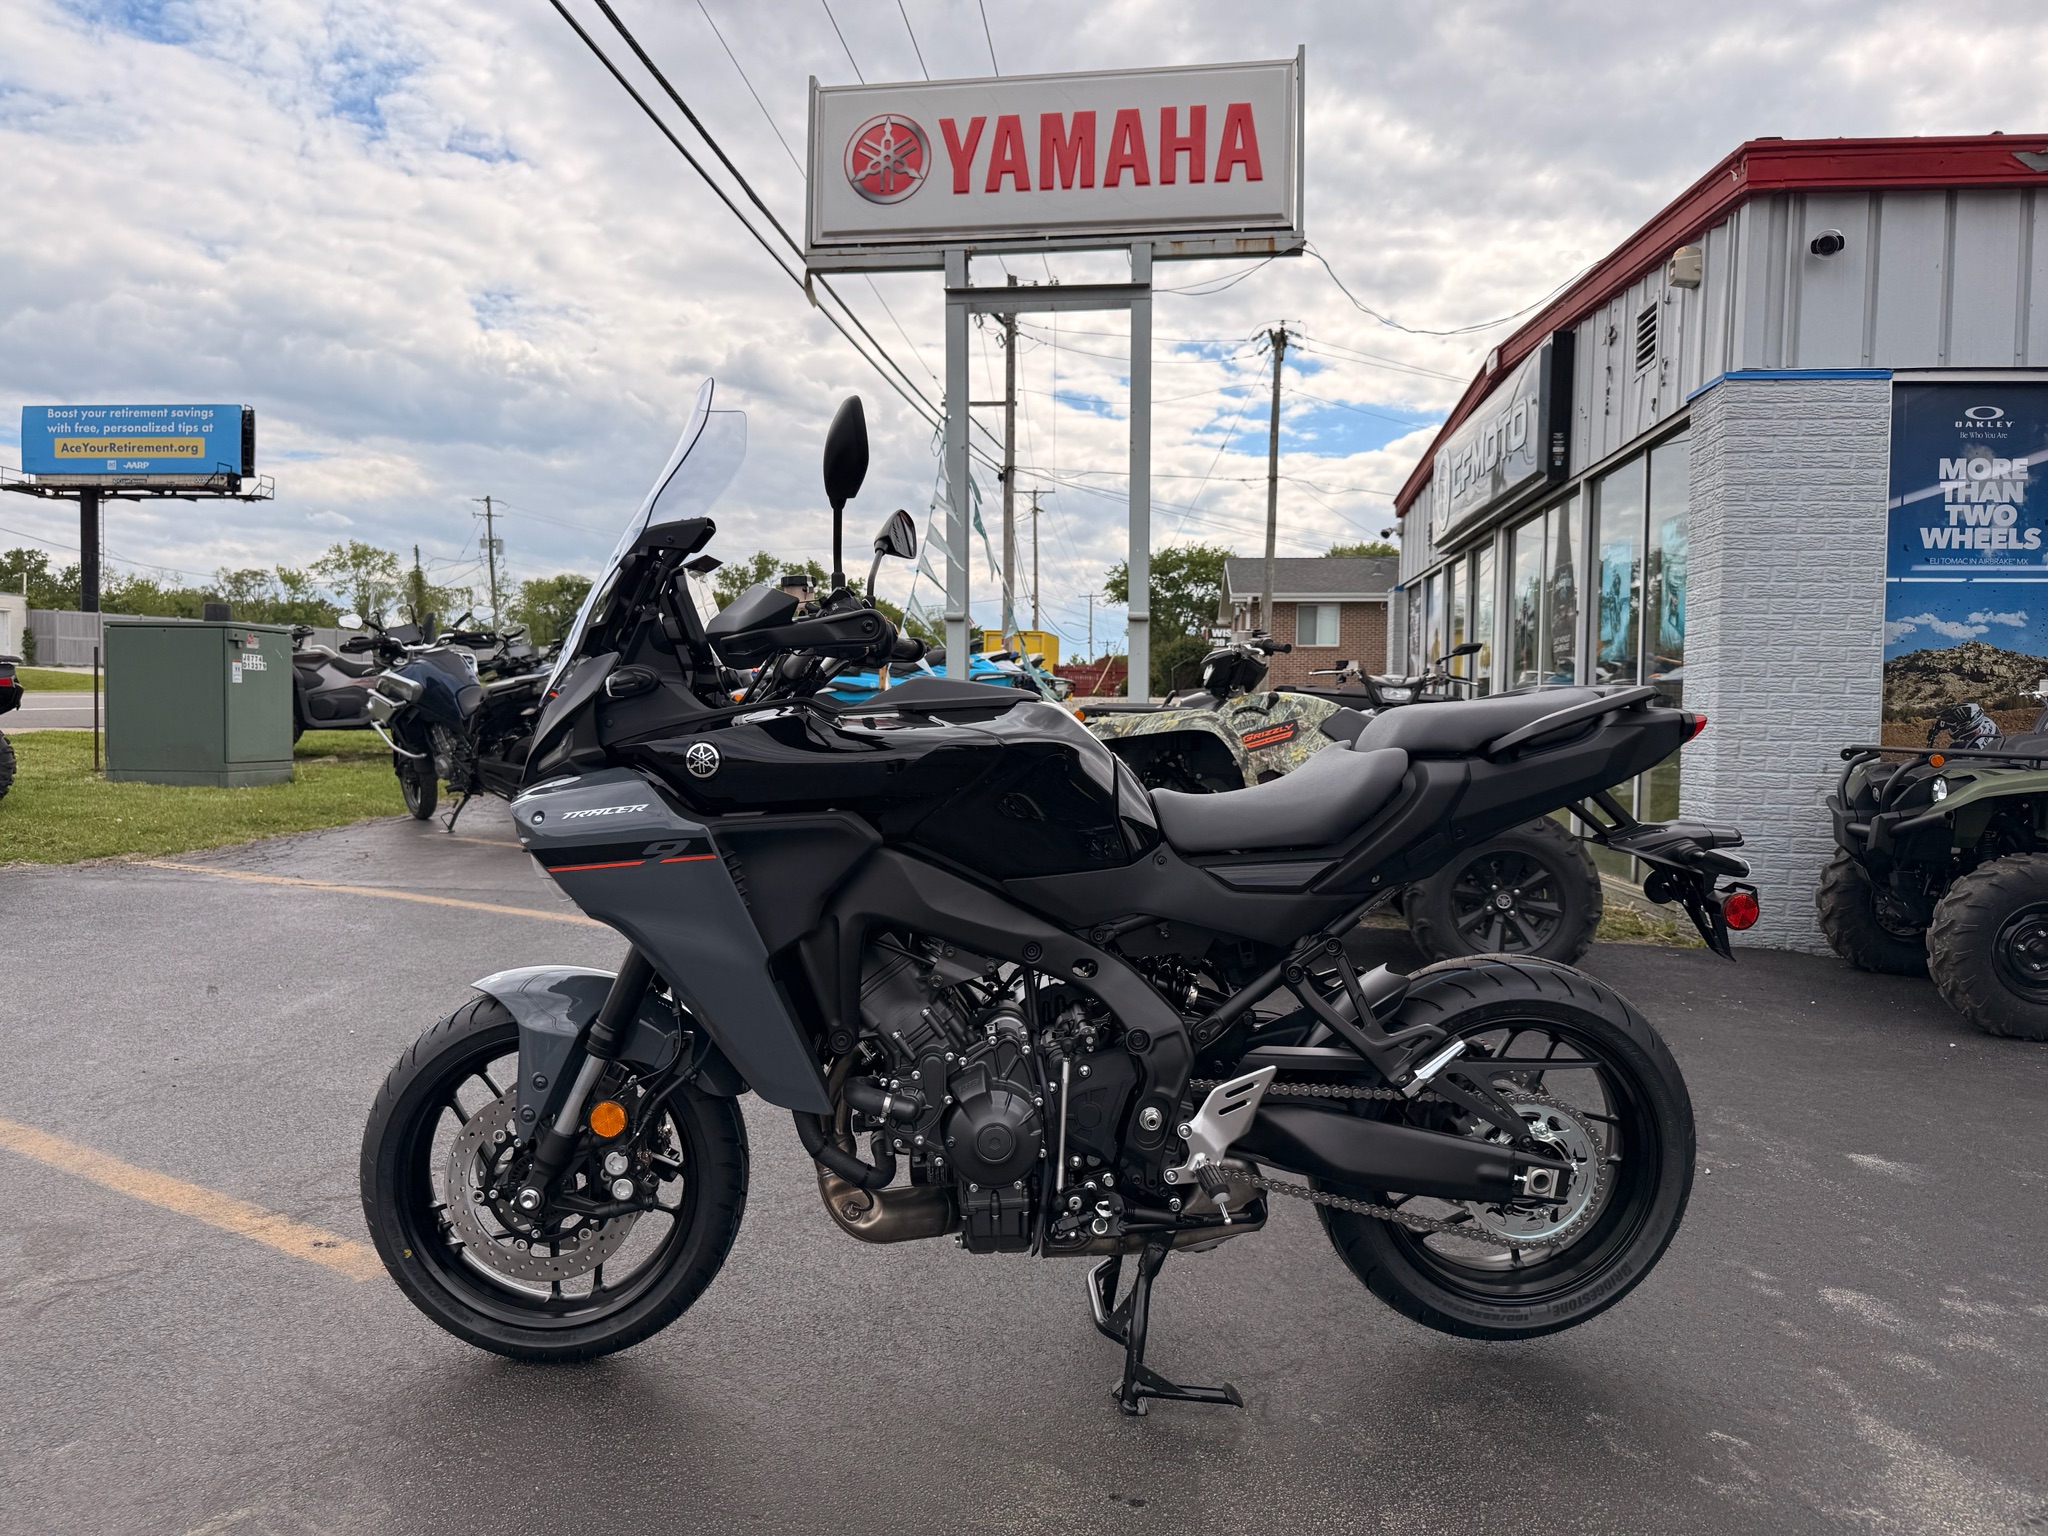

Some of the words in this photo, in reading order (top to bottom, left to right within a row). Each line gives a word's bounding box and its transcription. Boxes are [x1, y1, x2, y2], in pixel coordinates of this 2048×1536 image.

[938, 102, 1264, 194] YAMAHA
[47, 408, 78, 419] Boost
[81, 409, 107, 420] your
[109, 408, 169, 419] retirement
[171, 408, 214, 420] savings
[47, 423, 72, 434] with
[74, 423, 100, 435] free,
[103, 422, 175, 436] personalized
[178, 422, 199, 435] tips
[201, 423, 214, 434] at
[1954, 420, 2013, 428] OAKLEY
[1959, 431, 1968, 439] Be
[1969, 431, 1983, 439] Who
[1984, 431, 1996, 439] You
[1997, 431, 2008, 439] Are
[60, 442, 199, 456] AceYourRetirement.org
[1453, 396, 1528, 499] CFMOTO
[123, 461, 150, 470] AARP
[1939, 458, 2029, 481] MORE
[1939, 481, 2024, 504] THAN
[1944, 504, 2018, 527] TWO
[1919, 527, 2042, 550] WHEELS
[1929, 557, 1940, 565] ELI
[1940, 557, 1968, 565] TOMAC
[1969, 557, 1977, 565] IN
[2016, 557, 2028, 565] MX
[1242, 723, 1294, 742] GRIZZLY
[561, 803, 650, 820] TRACER
[1551, 1261, 1634, 1318] BRIDGESTONE
